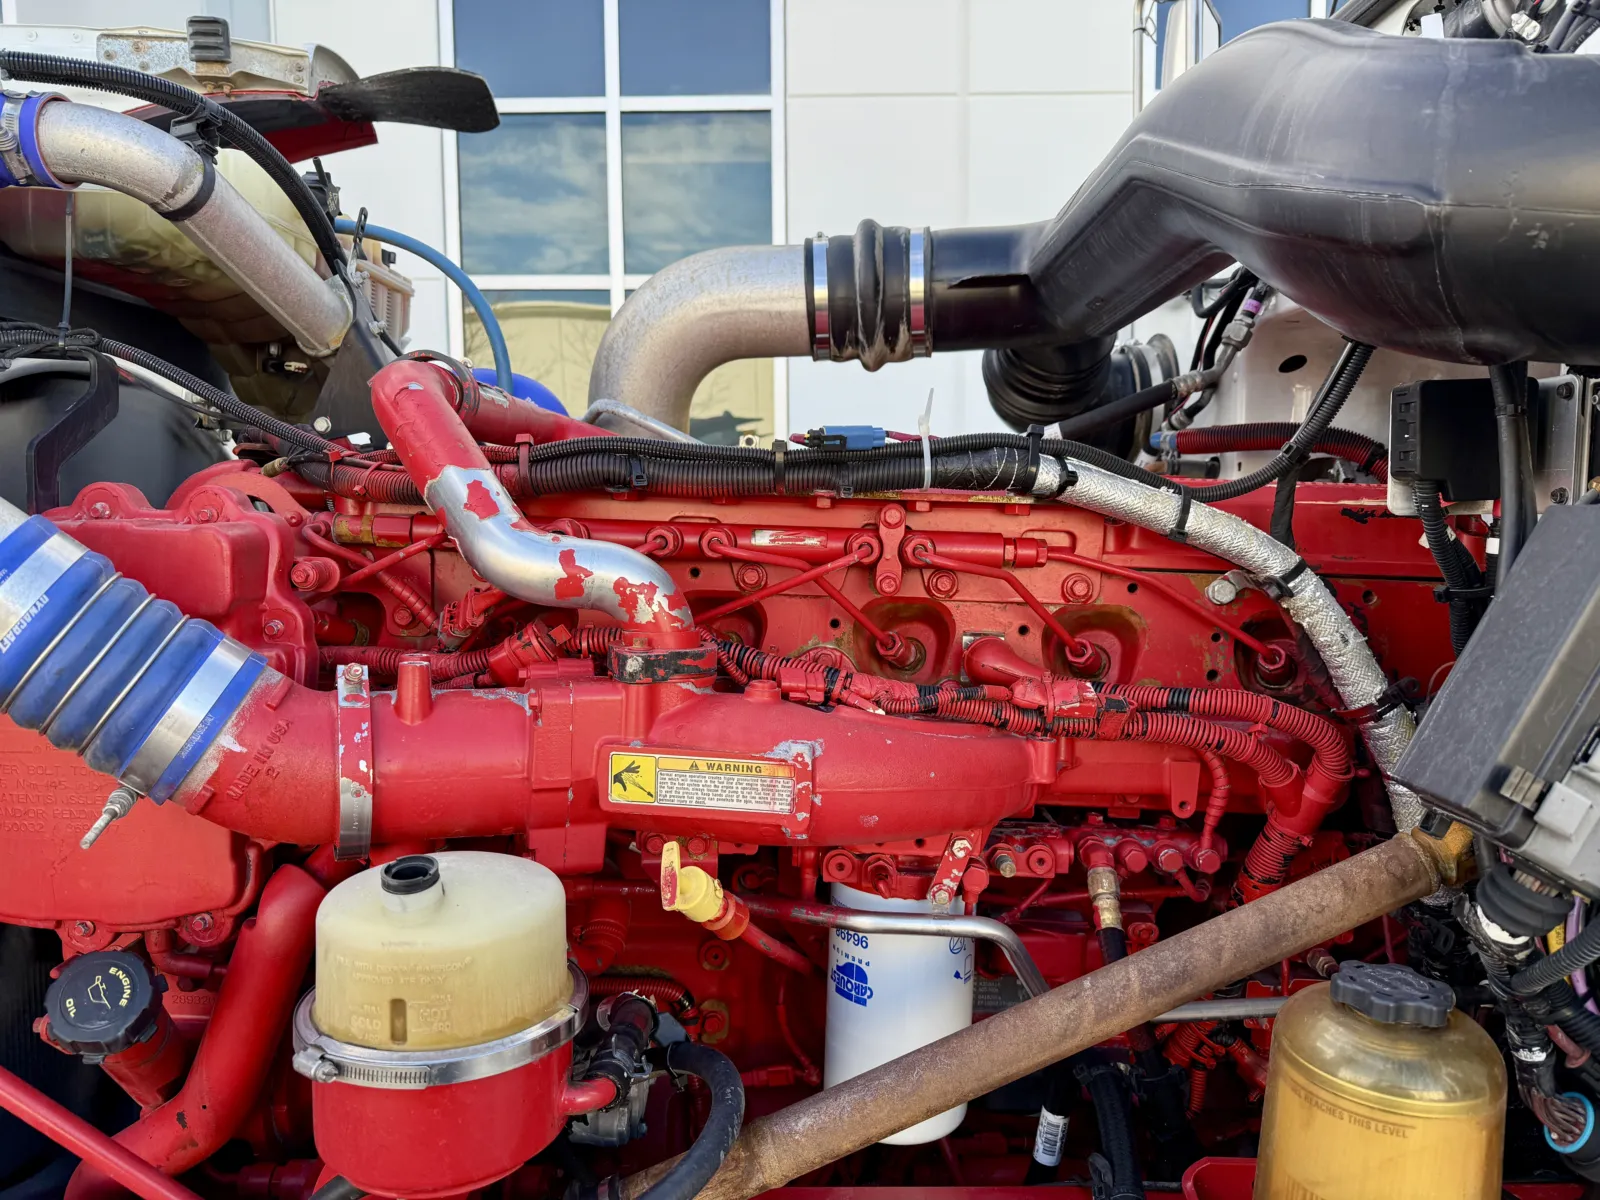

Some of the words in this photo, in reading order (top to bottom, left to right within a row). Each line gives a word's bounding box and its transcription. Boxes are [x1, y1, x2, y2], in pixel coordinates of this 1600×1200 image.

[226, 764, 261, 801] MADE
[254, 744, 274, 764] IN
[268, 718, 294, 744] USA
[706, 762, 762, 774] WARNING
[108, 966, 133, 1007] ENGINE
[830, 967, 874, 1000] CARQUEST
[65, 998, 78, 1018] OIL
[1348, 1114, 1372, 1132] THIS
[1375, 1125, 1408, 1139] LEVEL
